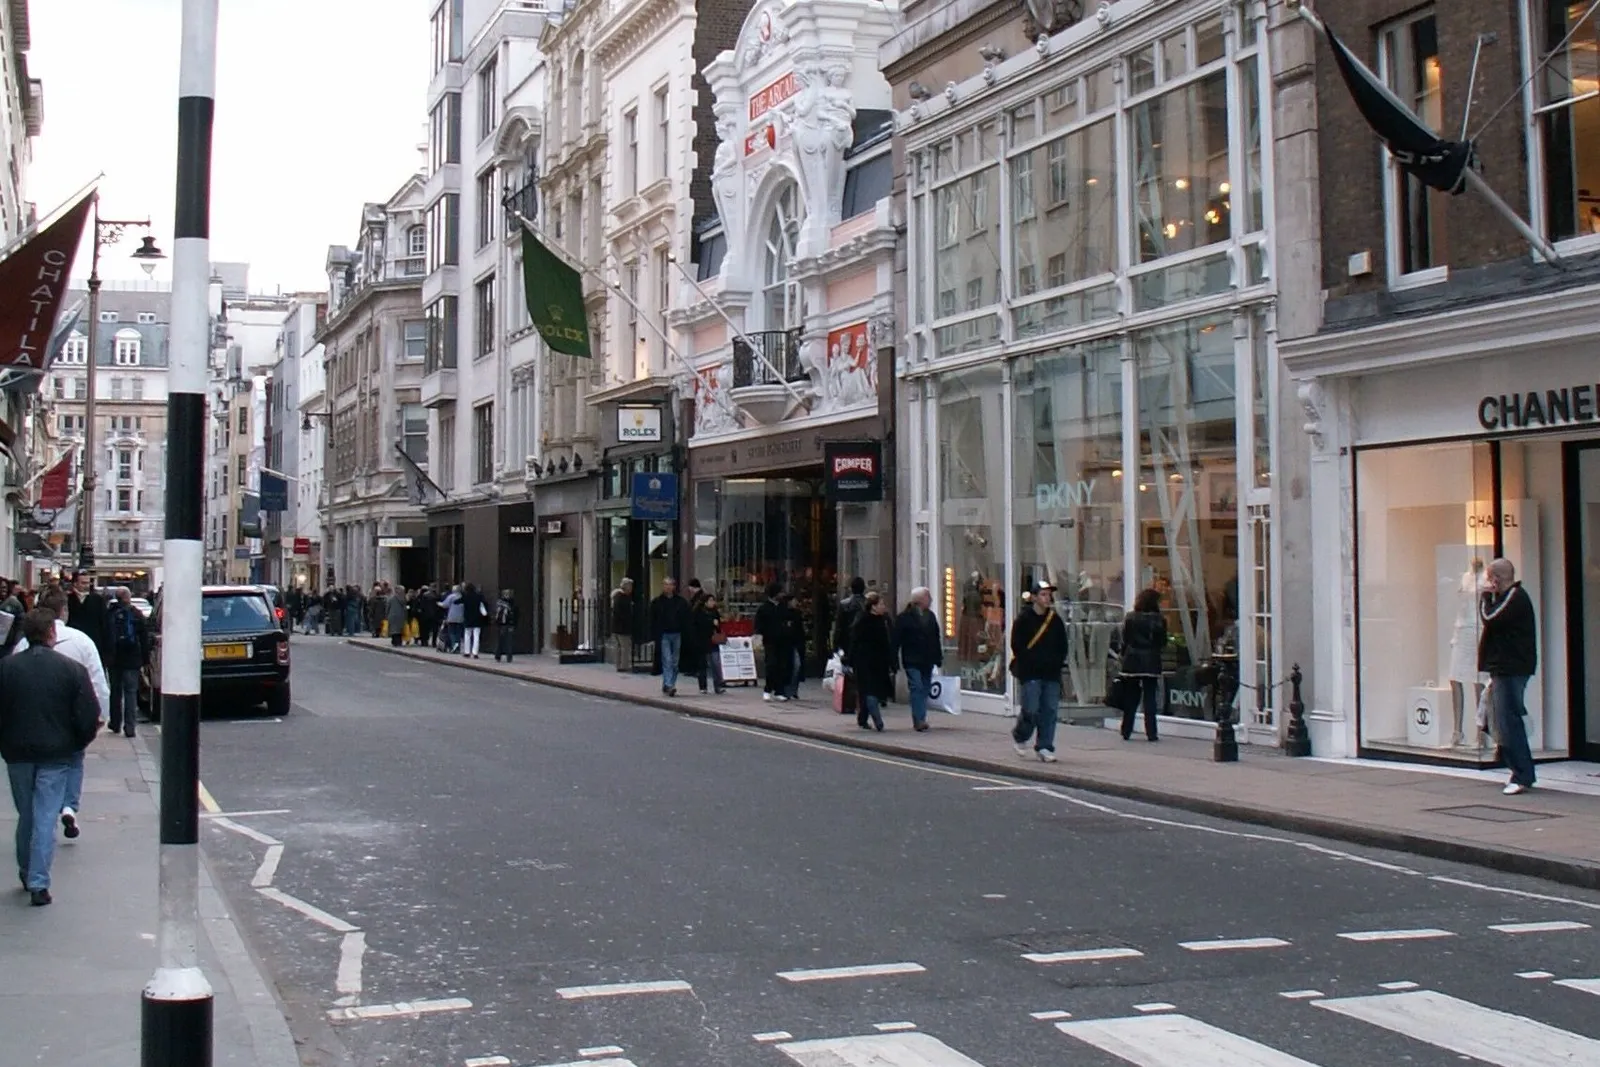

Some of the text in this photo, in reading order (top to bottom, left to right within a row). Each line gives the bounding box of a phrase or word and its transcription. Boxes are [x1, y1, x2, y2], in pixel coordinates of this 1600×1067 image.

[12, 249, 66, 367] CHATILA
[623, 427, 657, 436] ROLEX
[835, 457, 873, 473] CAMPER
[1035, 478, 1097, 510] DKNY
[1468, 513, 1518, 528] CHAEL
[510, 525, 535, 533] BALLY
[1170, 688, 1208, 708] DKNY
